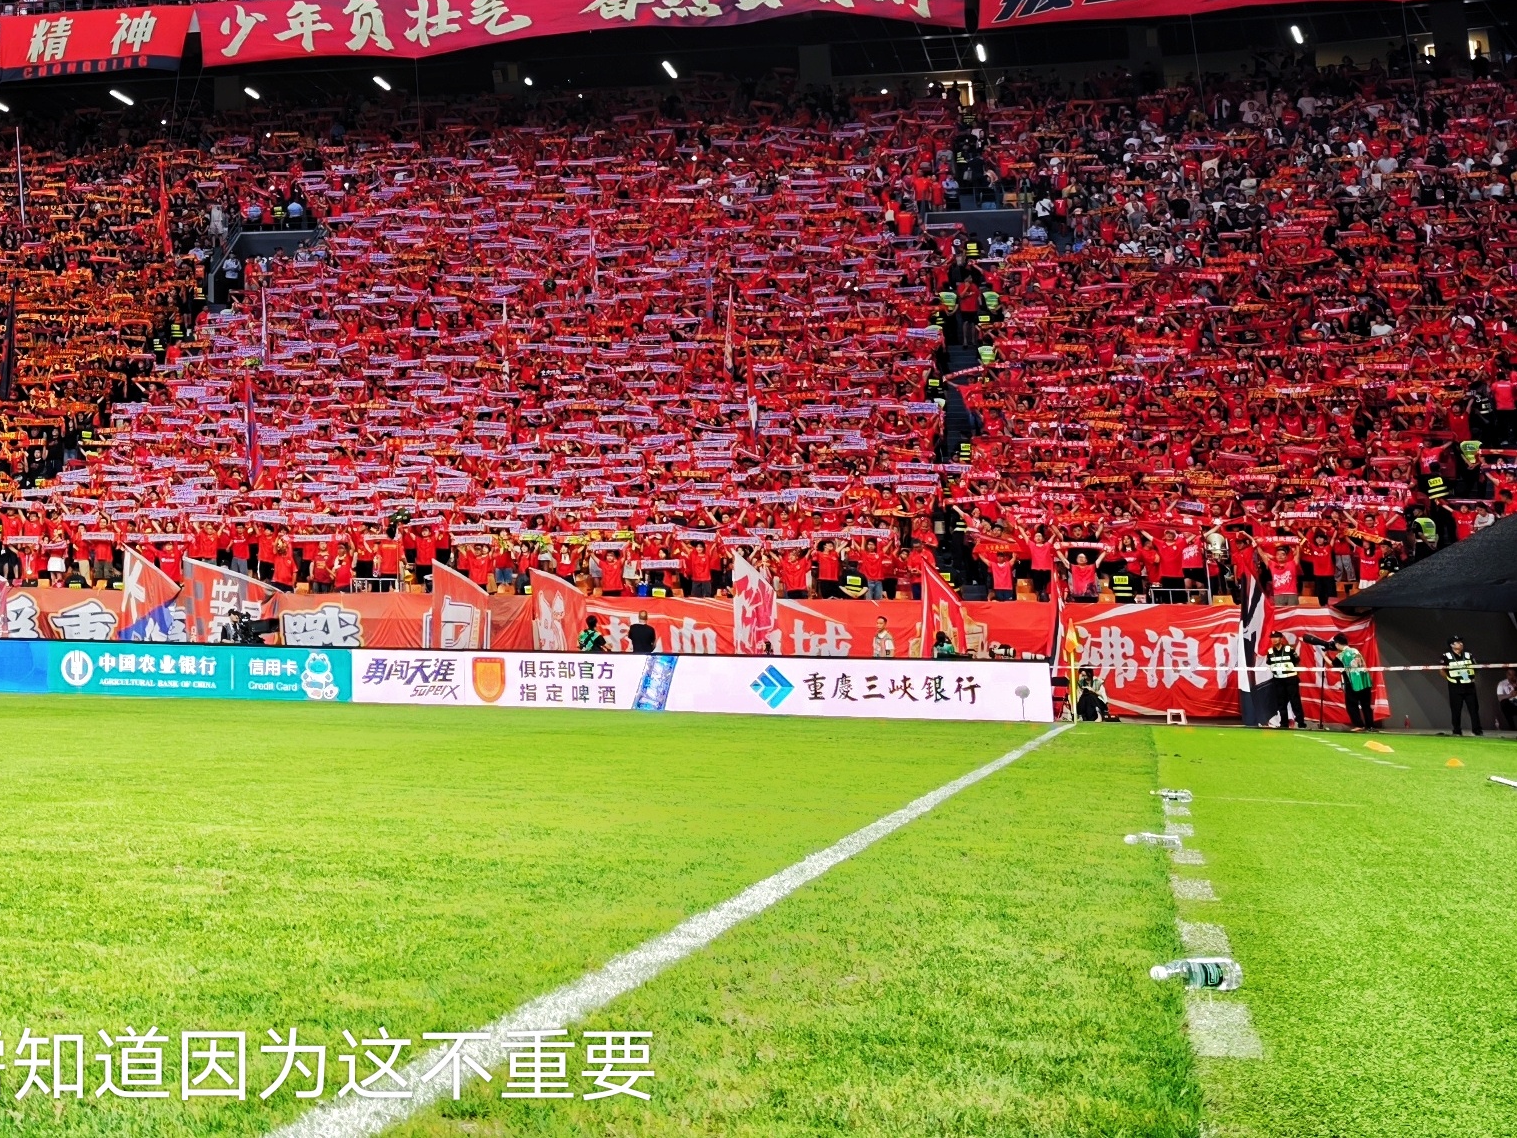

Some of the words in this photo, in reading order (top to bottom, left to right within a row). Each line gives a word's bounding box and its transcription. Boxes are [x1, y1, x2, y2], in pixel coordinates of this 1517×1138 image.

[98, 653, 217, 676] 中国农业银行
[248, 658, 298, 677] 信用卡
[362, 657, 457, 685] 勇闯天涯
[518, 660, 615, 680] 俱乐部官方
[248, 681, 274, 691] Credit
[276, 681, 298, 692] Card
[519, 684, 617, 704] 指定啤酒
[803, 672, 981, 704] 重慶三峽銀行
